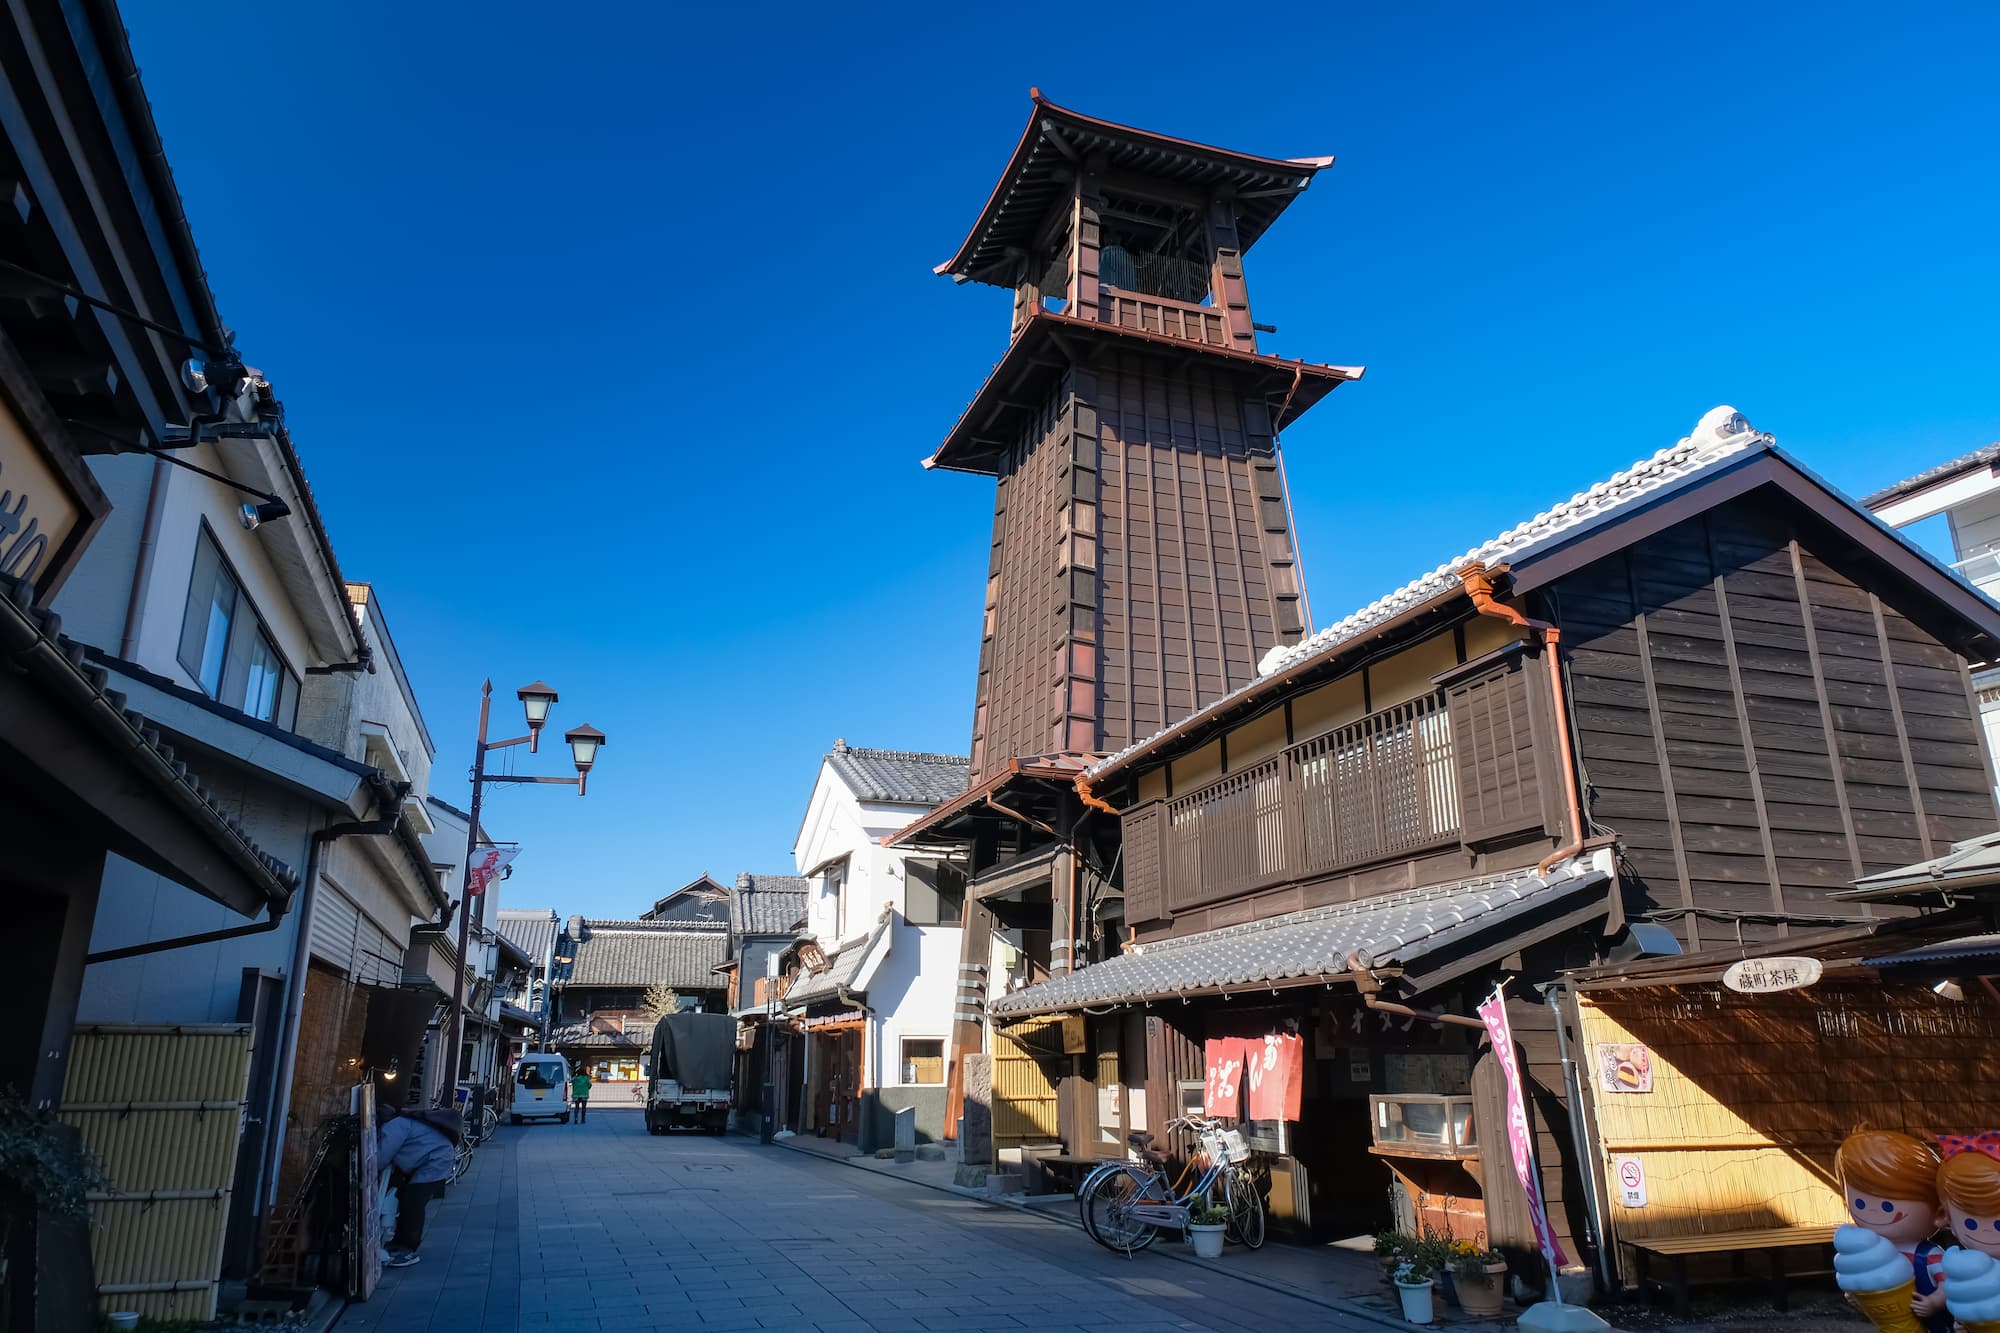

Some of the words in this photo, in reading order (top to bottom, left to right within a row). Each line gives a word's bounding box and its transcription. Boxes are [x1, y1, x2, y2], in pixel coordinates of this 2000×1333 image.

[1739, 968, 1799, 989] 蔵町茶屋
[1627, 1191, 1640, 1200] 禁煙
